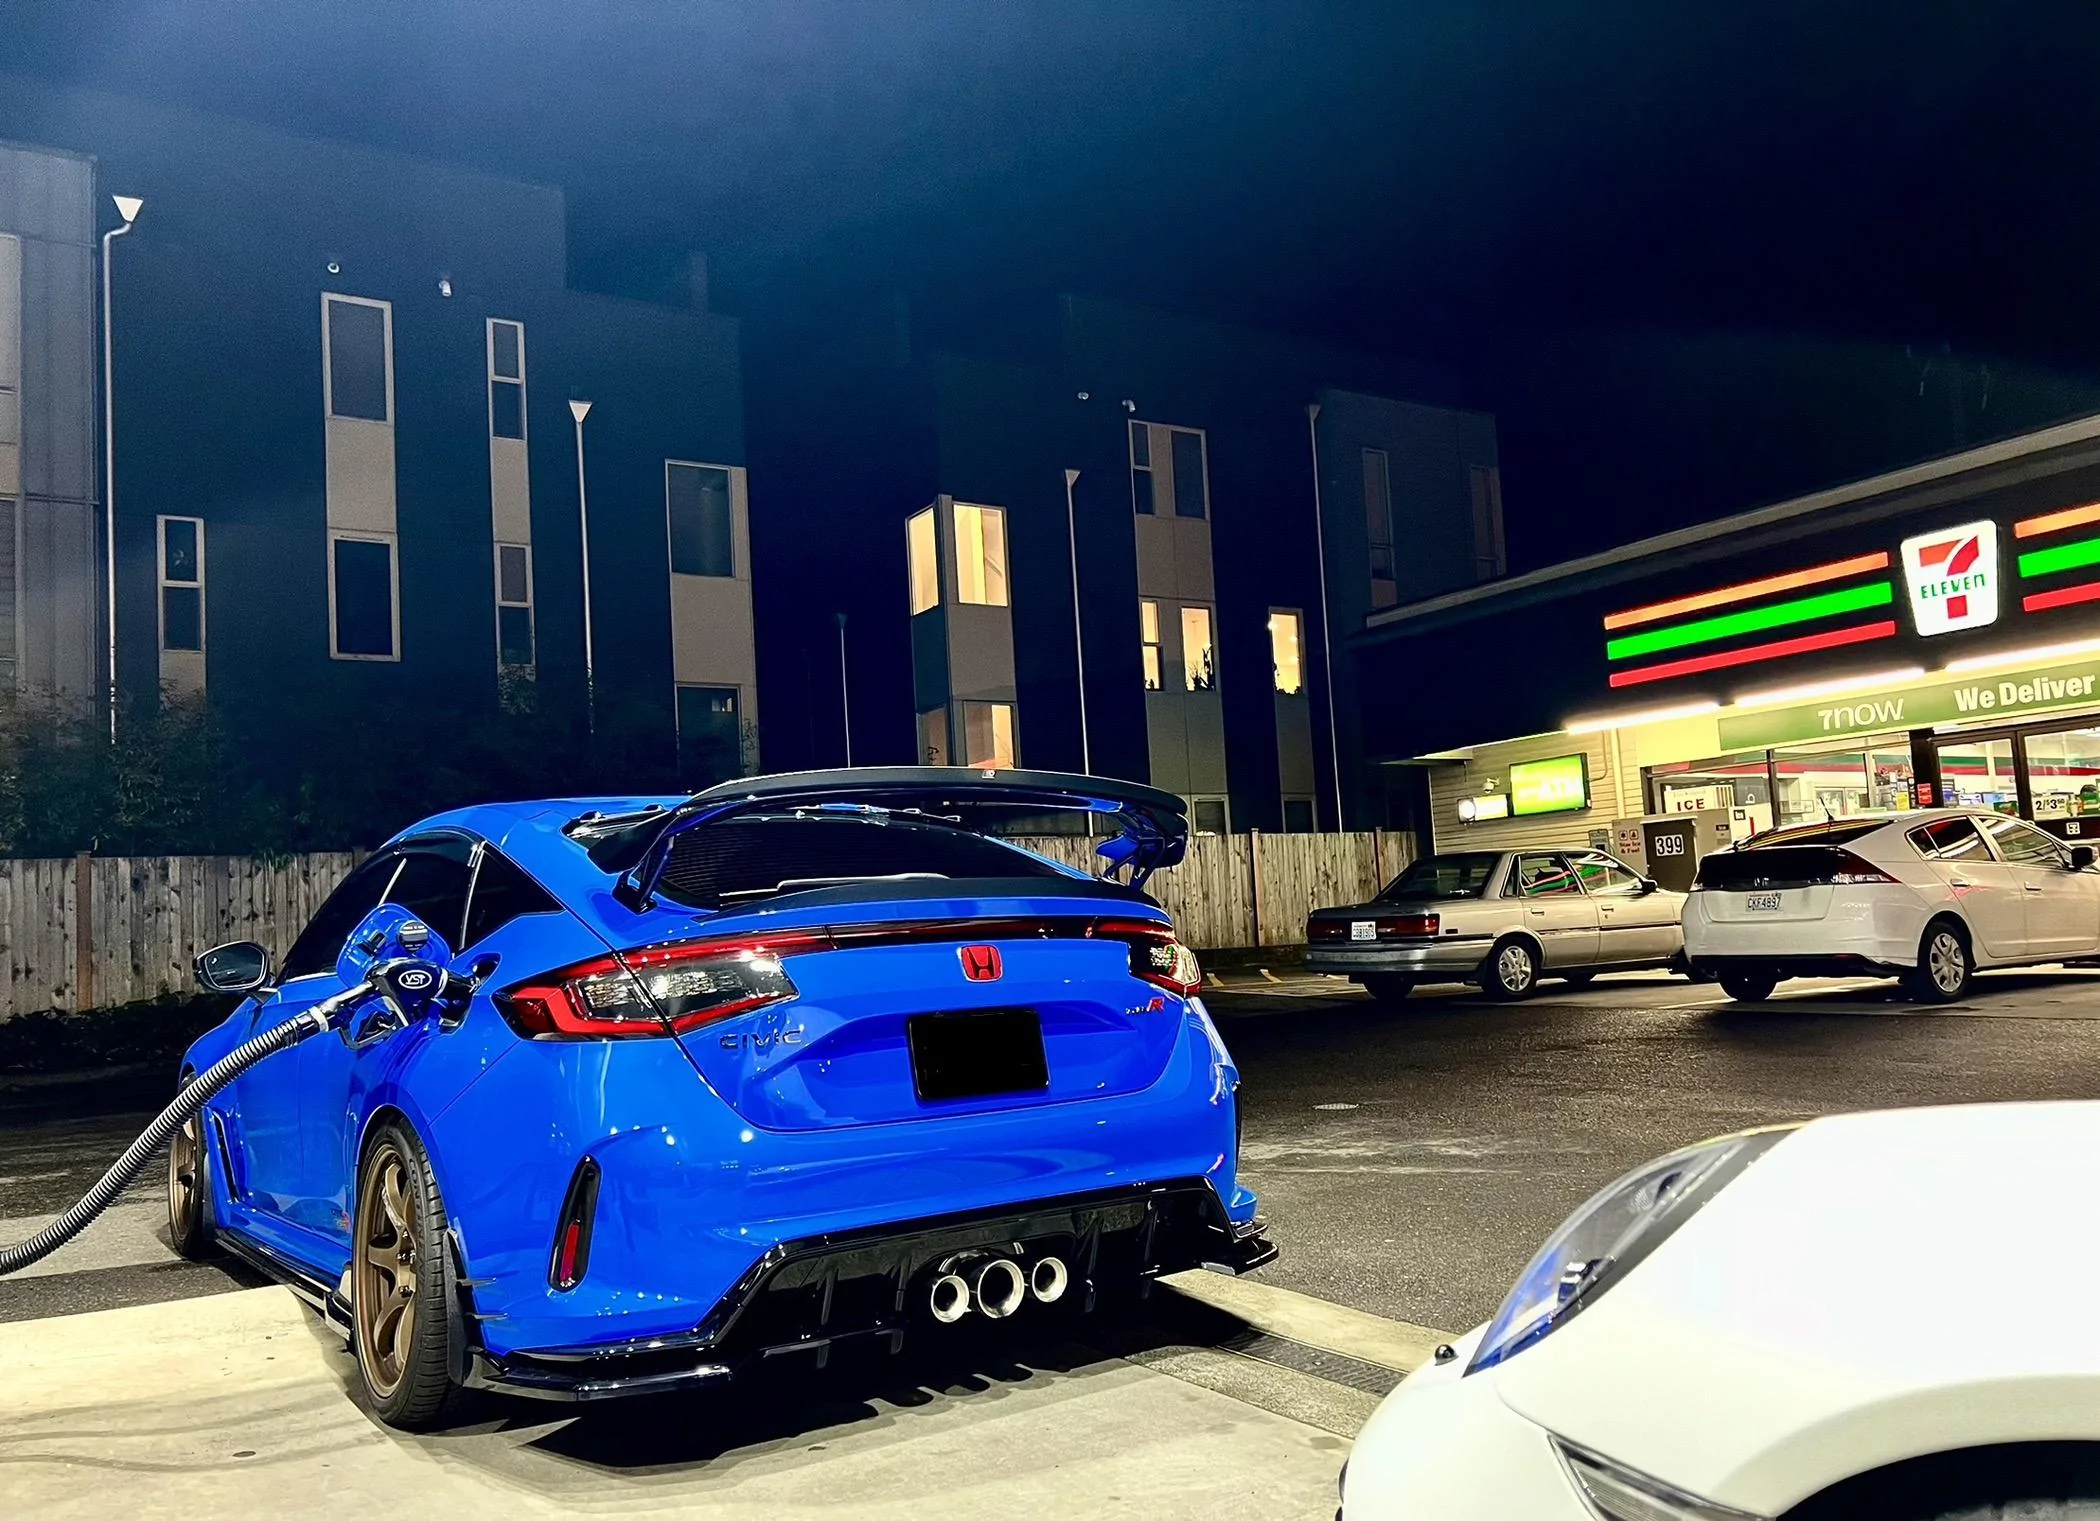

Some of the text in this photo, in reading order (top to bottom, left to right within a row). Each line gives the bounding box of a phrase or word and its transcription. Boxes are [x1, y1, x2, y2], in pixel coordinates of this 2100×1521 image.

[1953, 675, 2096, 712] We Deliver
[1677, 798, 1705, 812] ICE
[1656, 836, 1683, 855] 399
